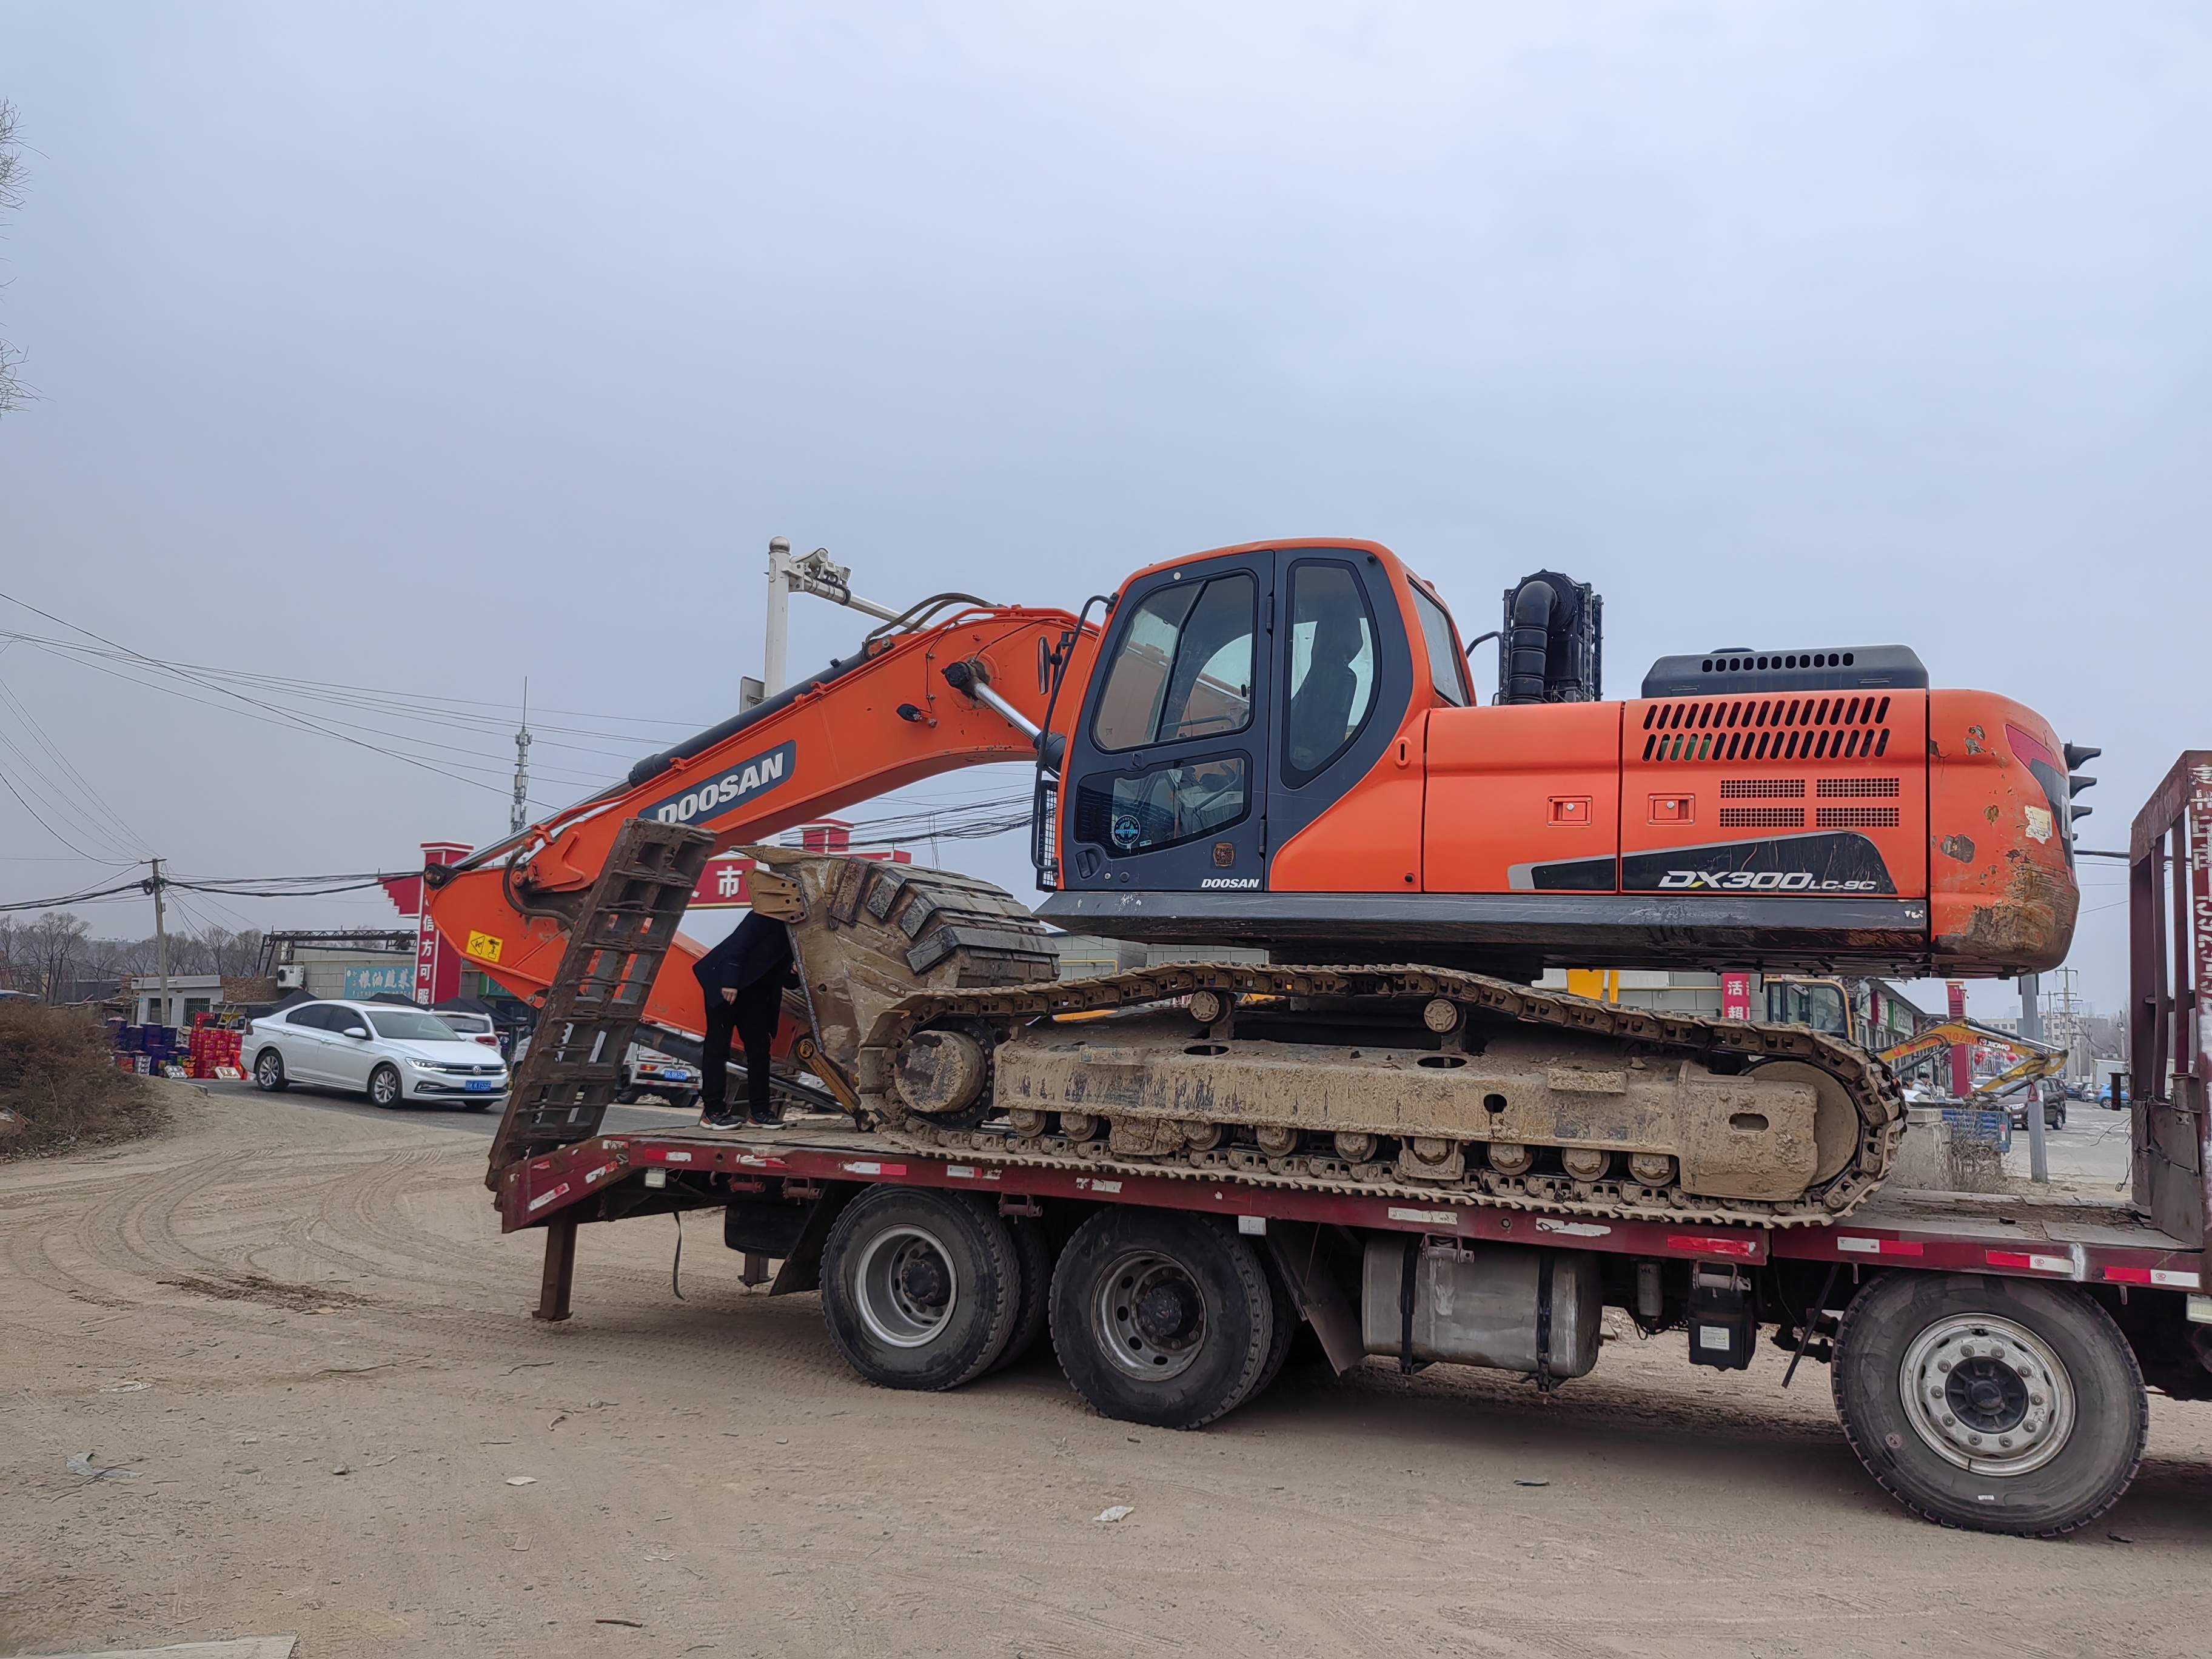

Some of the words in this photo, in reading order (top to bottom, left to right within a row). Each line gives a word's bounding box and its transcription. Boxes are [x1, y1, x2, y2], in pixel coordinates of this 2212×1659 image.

[658, 752, 783, 823] DOOSAN
[1201, 879, 1259, 888] DOOSAN
[417, 894, 435, 1005] 信方可服
